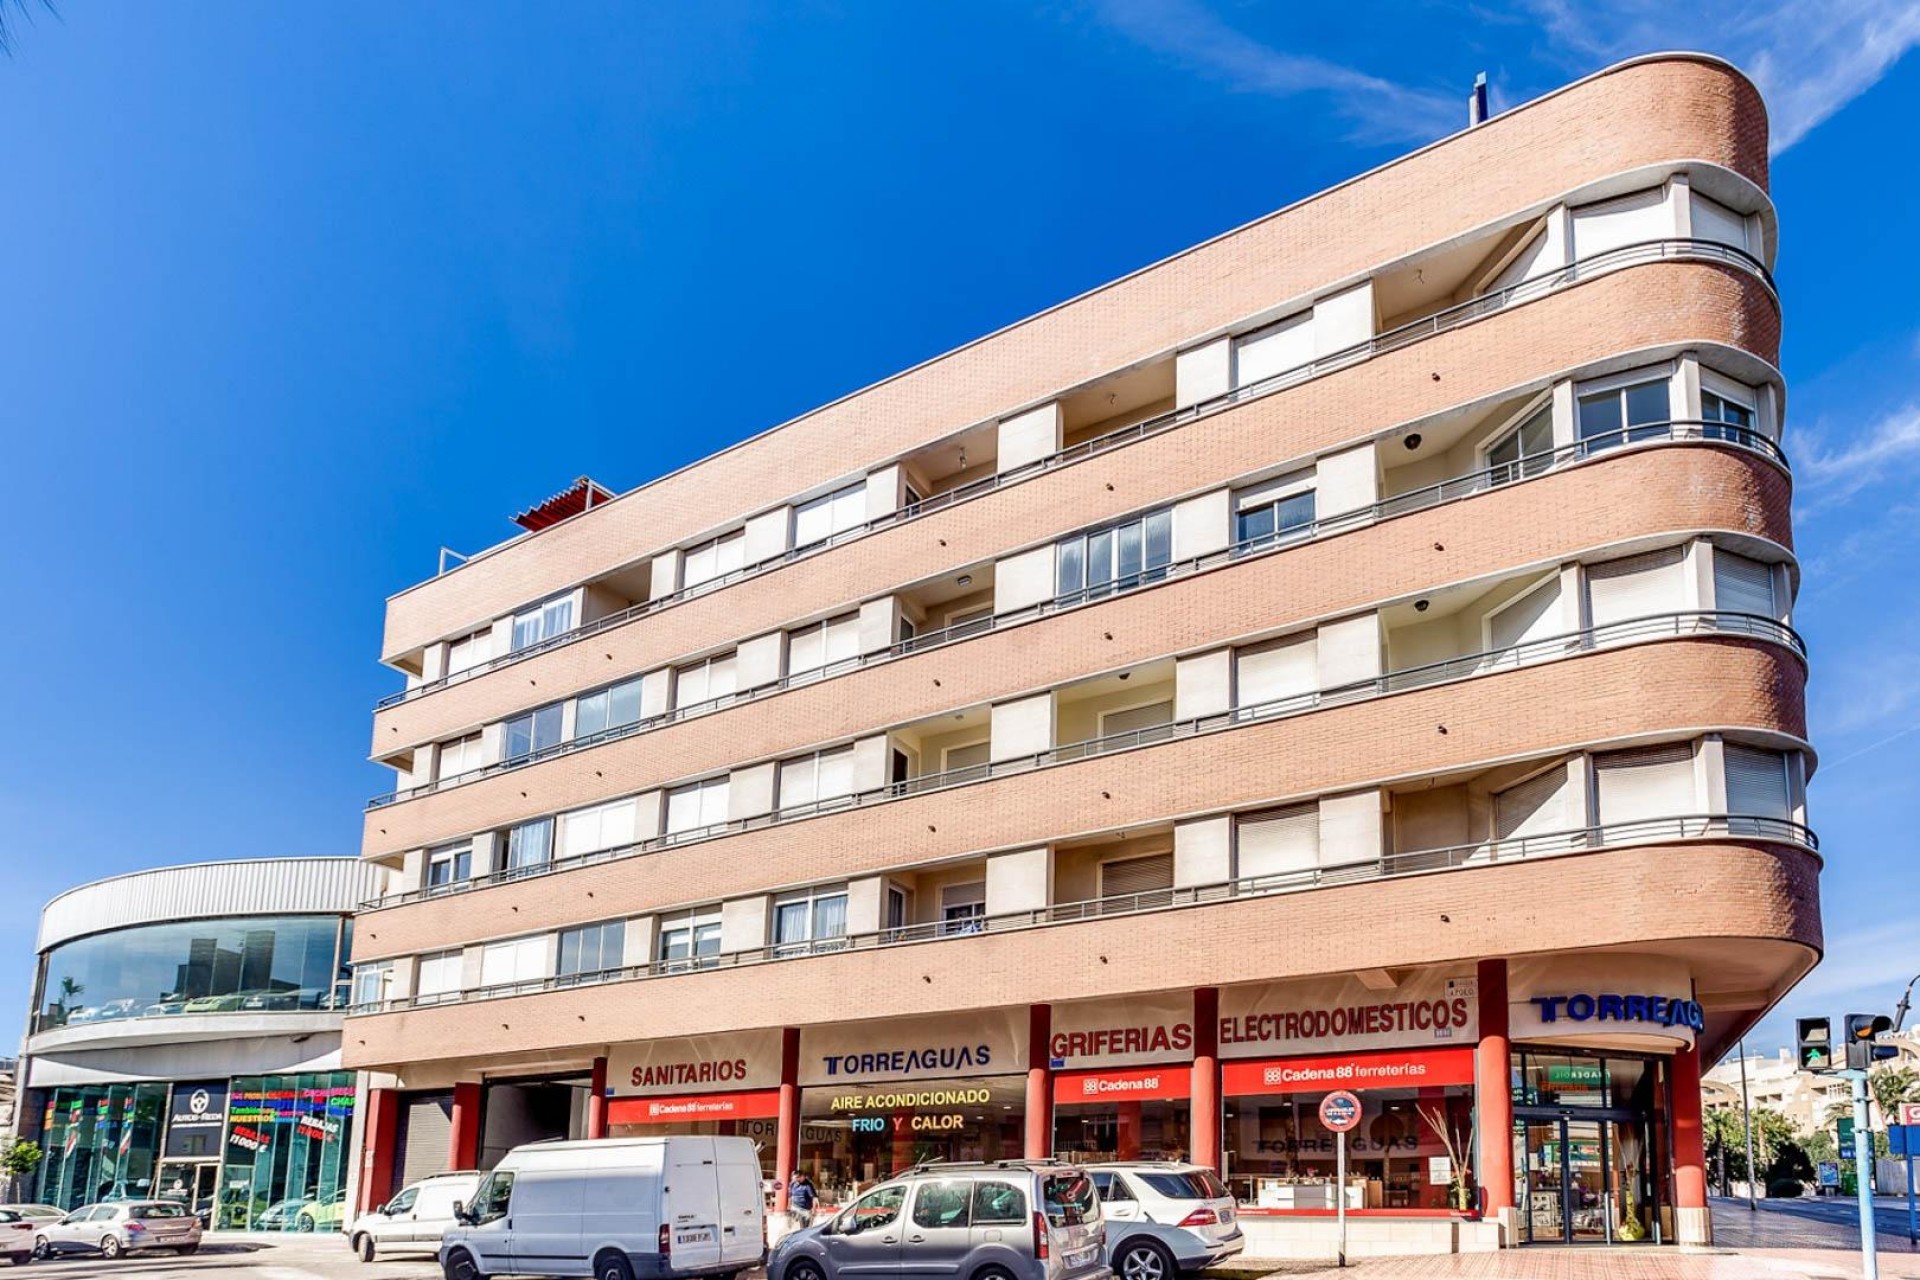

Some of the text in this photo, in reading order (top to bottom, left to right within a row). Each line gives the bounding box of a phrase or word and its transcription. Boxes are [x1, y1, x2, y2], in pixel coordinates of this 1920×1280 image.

[1220, 998, 1468, 1044] ELECTRODOMESTICOS
[1050, 1023, 1192, 1058] GRIFERIAS
[823, 1045, 991, 1075] TORREAGUAS
[631, 1059, 747, 1087] SANITARIOS
[1099, 1079, 1143, 1092] Cadena
[1144, 1077, 1159, 1089] 88
[1282, 1067, 1335, 1082] Cadena
[1335, 1066, 1353, 1079] 88
[831, 1088, 991, 1111] AIRE ACONDICIONADO
[852, 1114, 964, 1132] FRIO Y CALOR
